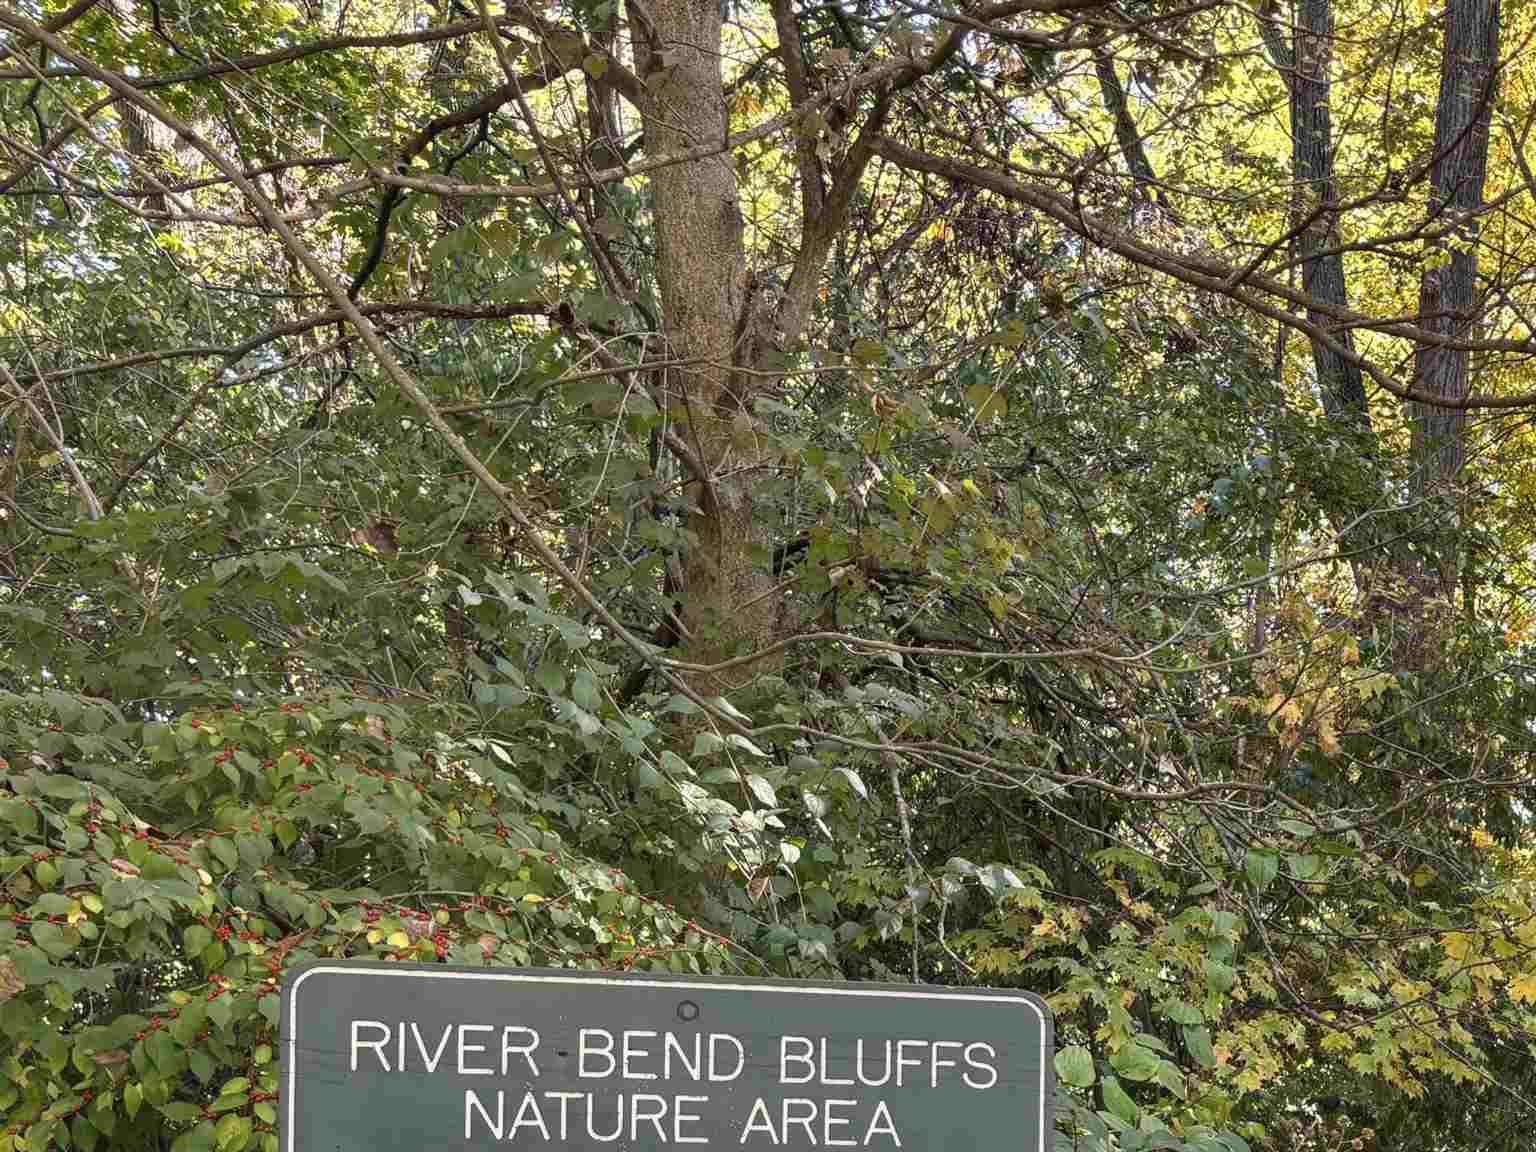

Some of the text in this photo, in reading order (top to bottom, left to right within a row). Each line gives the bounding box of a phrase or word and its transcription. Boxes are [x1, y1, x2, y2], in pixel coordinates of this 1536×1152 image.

[351, 1021, 998, 1089] RIVER BEND BLUFFS
[465, 1090, 902, 1147] NATURE AREA
